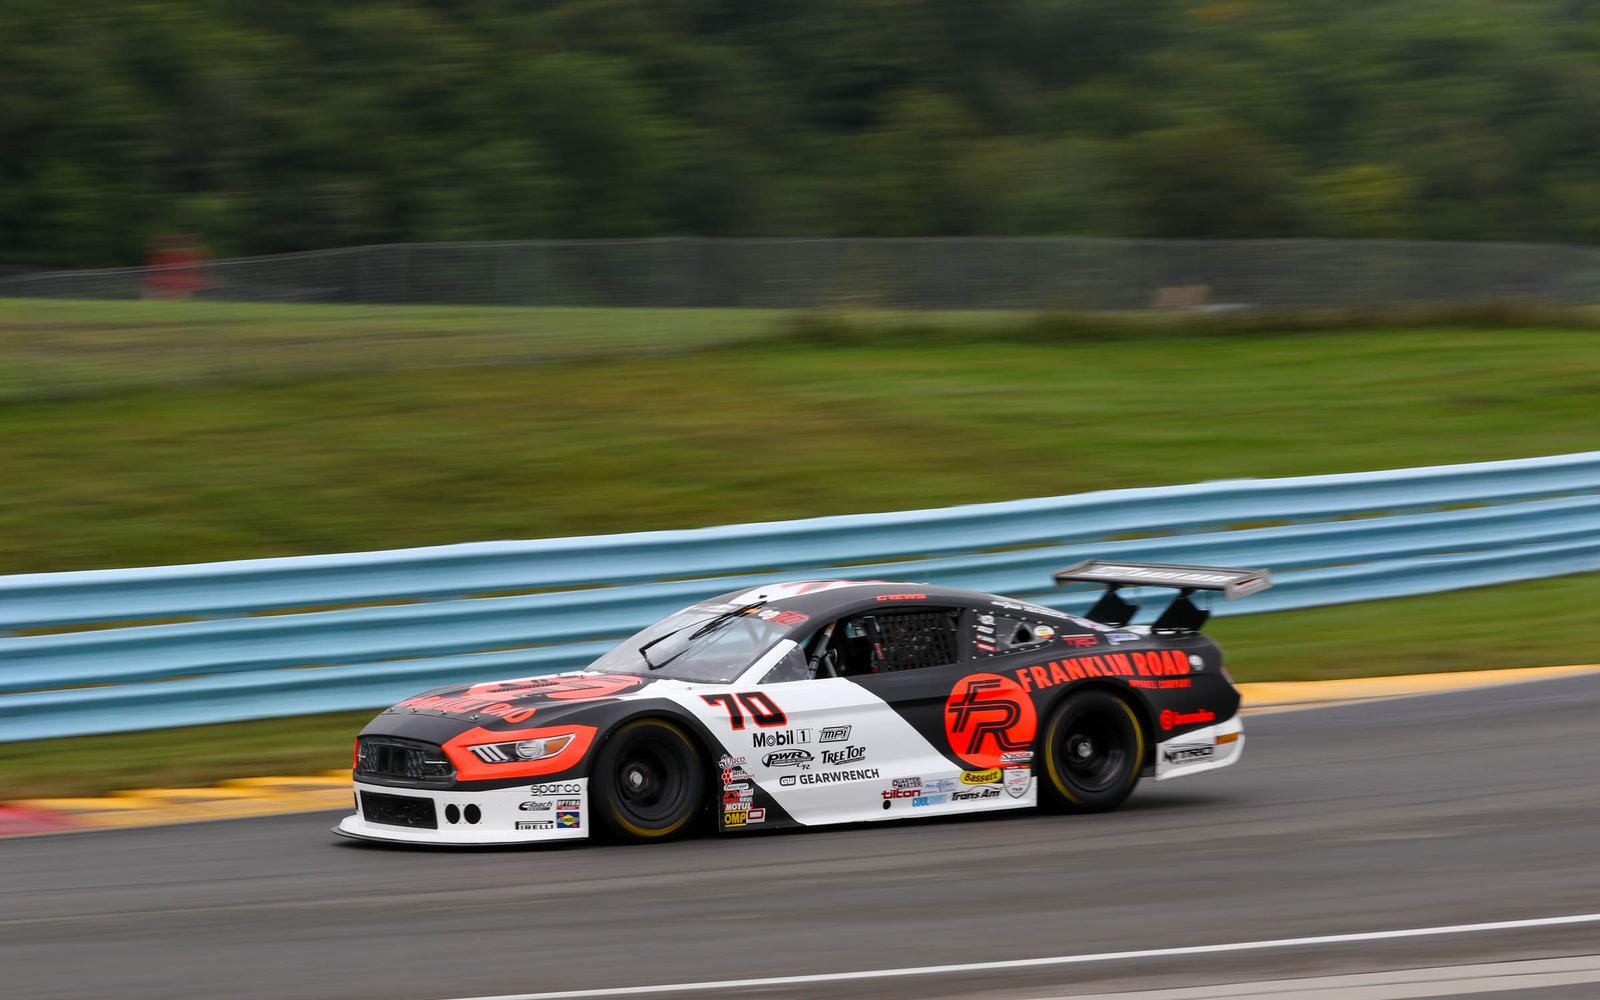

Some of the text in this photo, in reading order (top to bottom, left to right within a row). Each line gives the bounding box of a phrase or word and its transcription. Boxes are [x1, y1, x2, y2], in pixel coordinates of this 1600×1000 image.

[1015, 650, 1190, 693] FRANKLIN ROAD
[699, 691, 788, 731] 70
[753, 730, 794, 748] Mobil
[767, 751, 804, 768] PWR
[1164, 746, 1214, 762] NITRO
[799, 768, 880, 785] GEARWRENCH
[964, 771, 998, 783] Bassett
[531, 783, 581, 796] sparco
[881, 789, 921, 800] tilton
[952, 788, 1000, 801] Trans Am
[725, 802, 752, 811] MOTUL
[724, 812, 747, 824] OMP
[515, 820, 554, 830] PIRELLI
